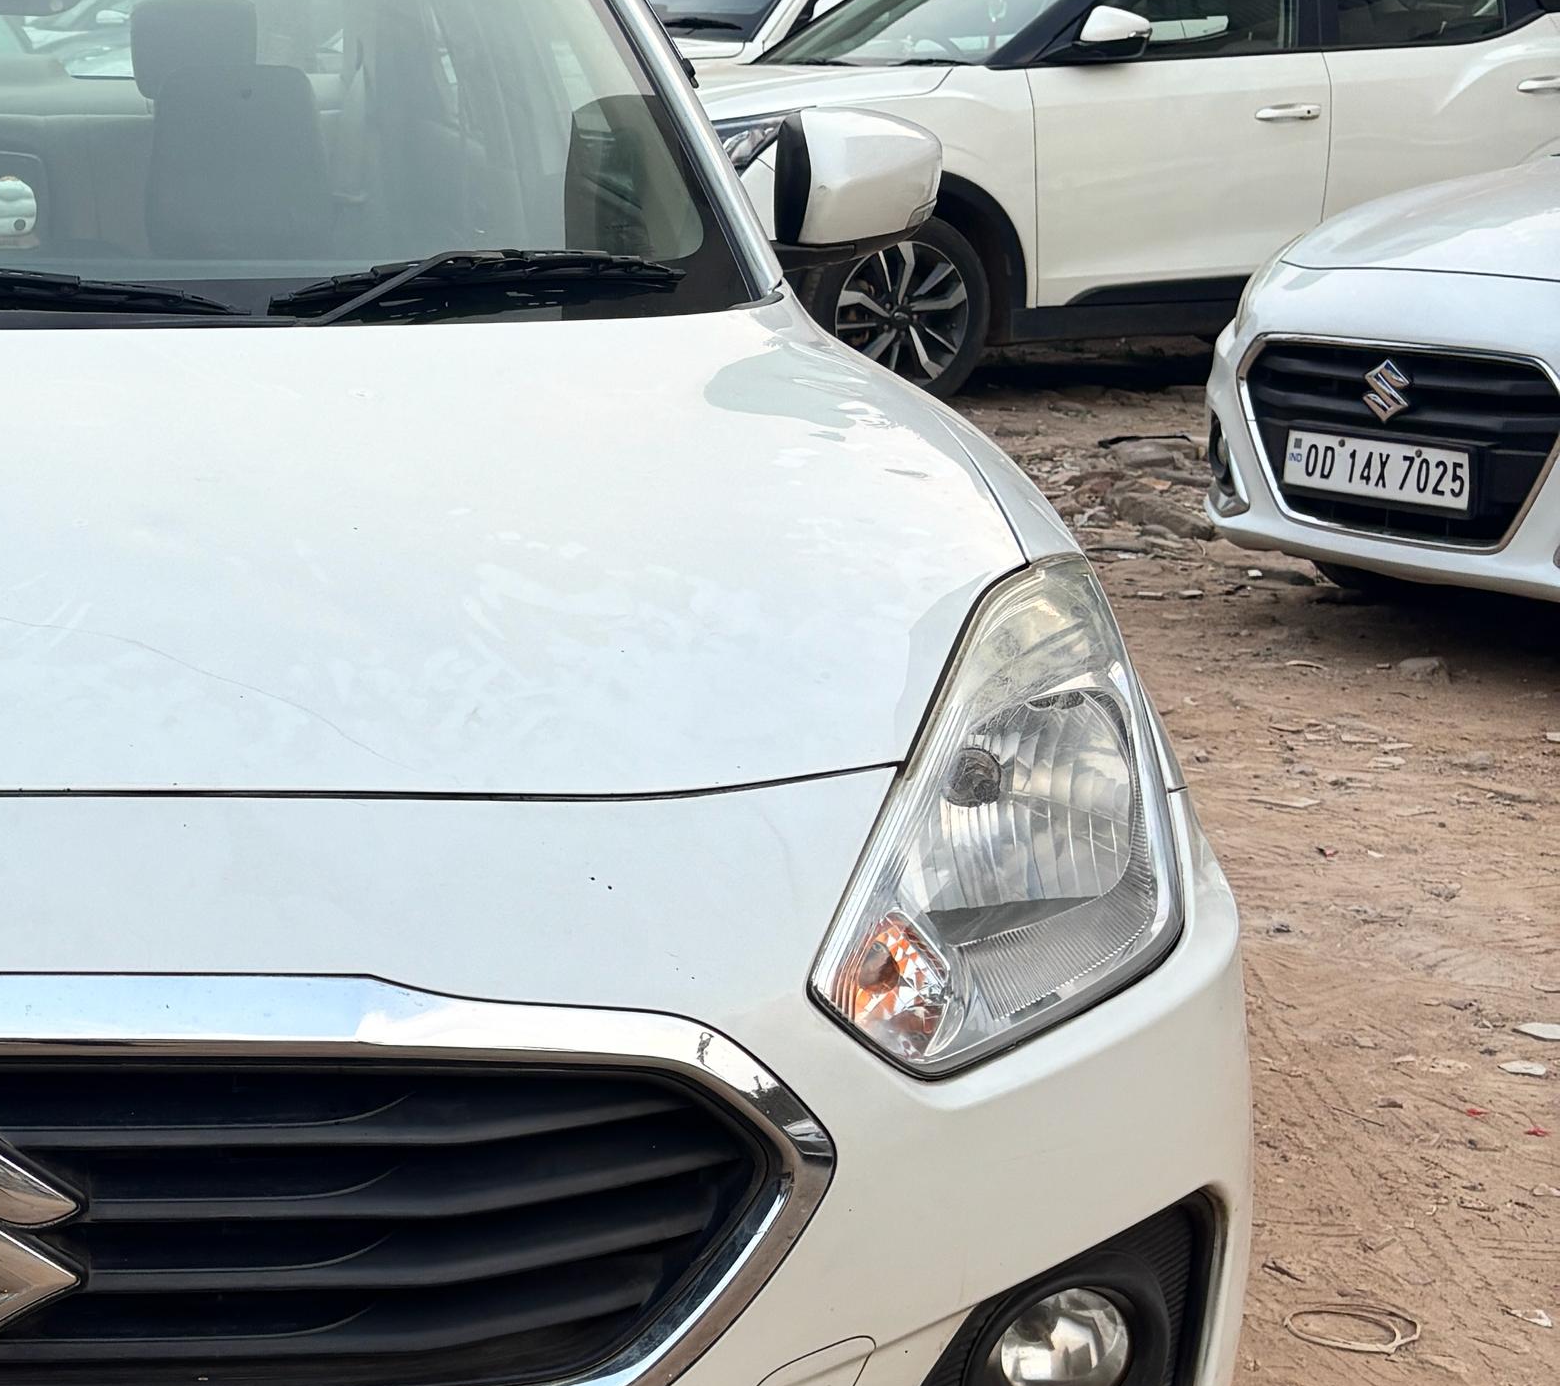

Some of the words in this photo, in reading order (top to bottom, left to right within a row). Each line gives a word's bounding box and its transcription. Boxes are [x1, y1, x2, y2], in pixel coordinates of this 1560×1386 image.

[1304, 443, 1336, 480] OD
[1348, 448, 1391, 489] 14X
[1398, 454, 1466, 498] 7025
